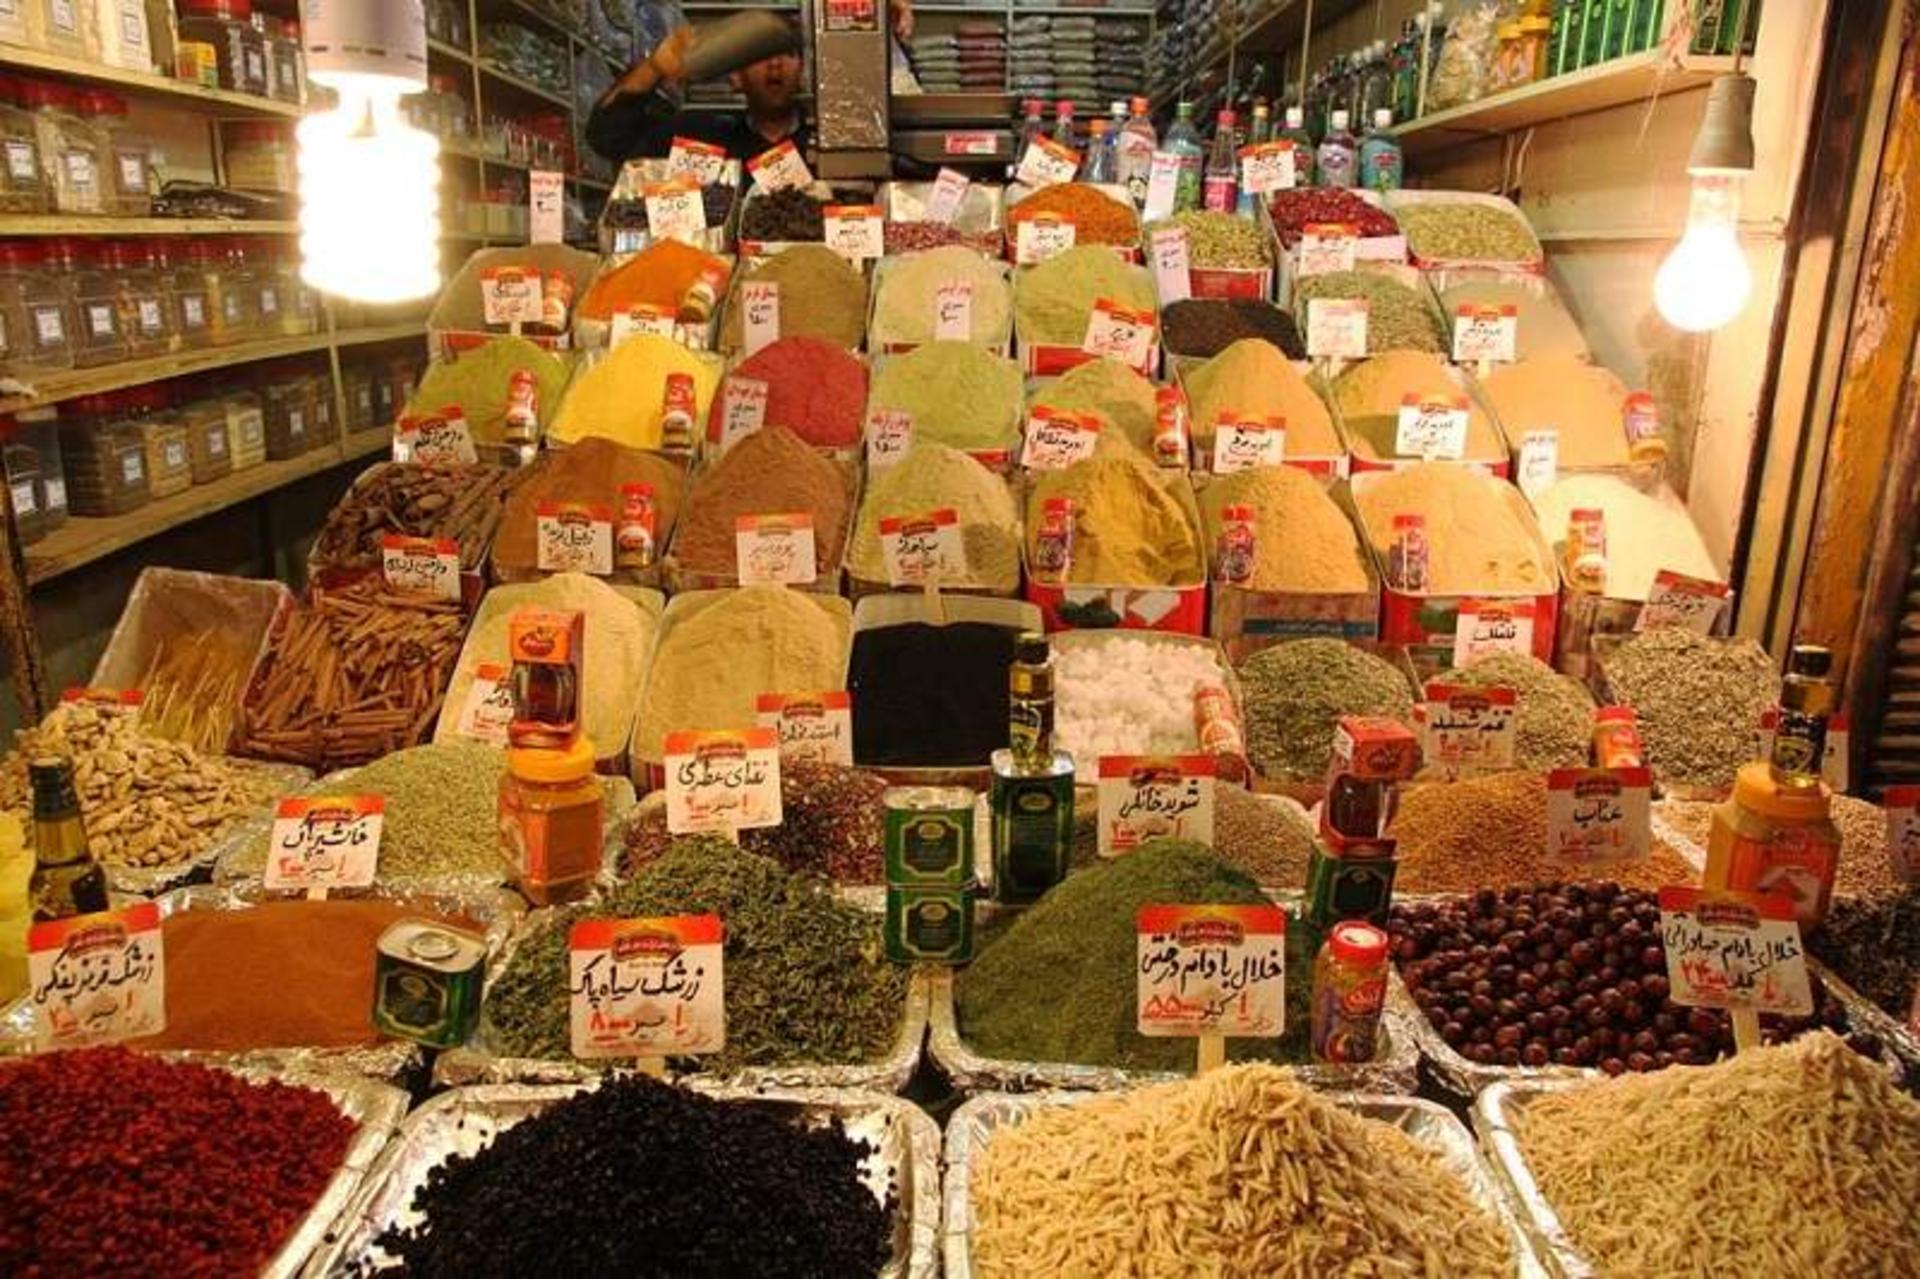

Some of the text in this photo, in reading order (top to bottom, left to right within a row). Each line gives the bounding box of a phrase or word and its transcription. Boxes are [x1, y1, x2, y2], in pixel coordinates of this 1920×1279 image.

[1573, 800, 1623, 829] عناب
[107, 941, 156, 986] زرشک
[569, 953, 605, 1009] پاک
[639, 949, 704, 1001] زرشک
[1141, 933, 1180, 985] درختی
[1180, 948, 1231, 994] بادام
[1230, 950, 1282, 989] خلال
[599, 964, 641, 1001] سیاه
